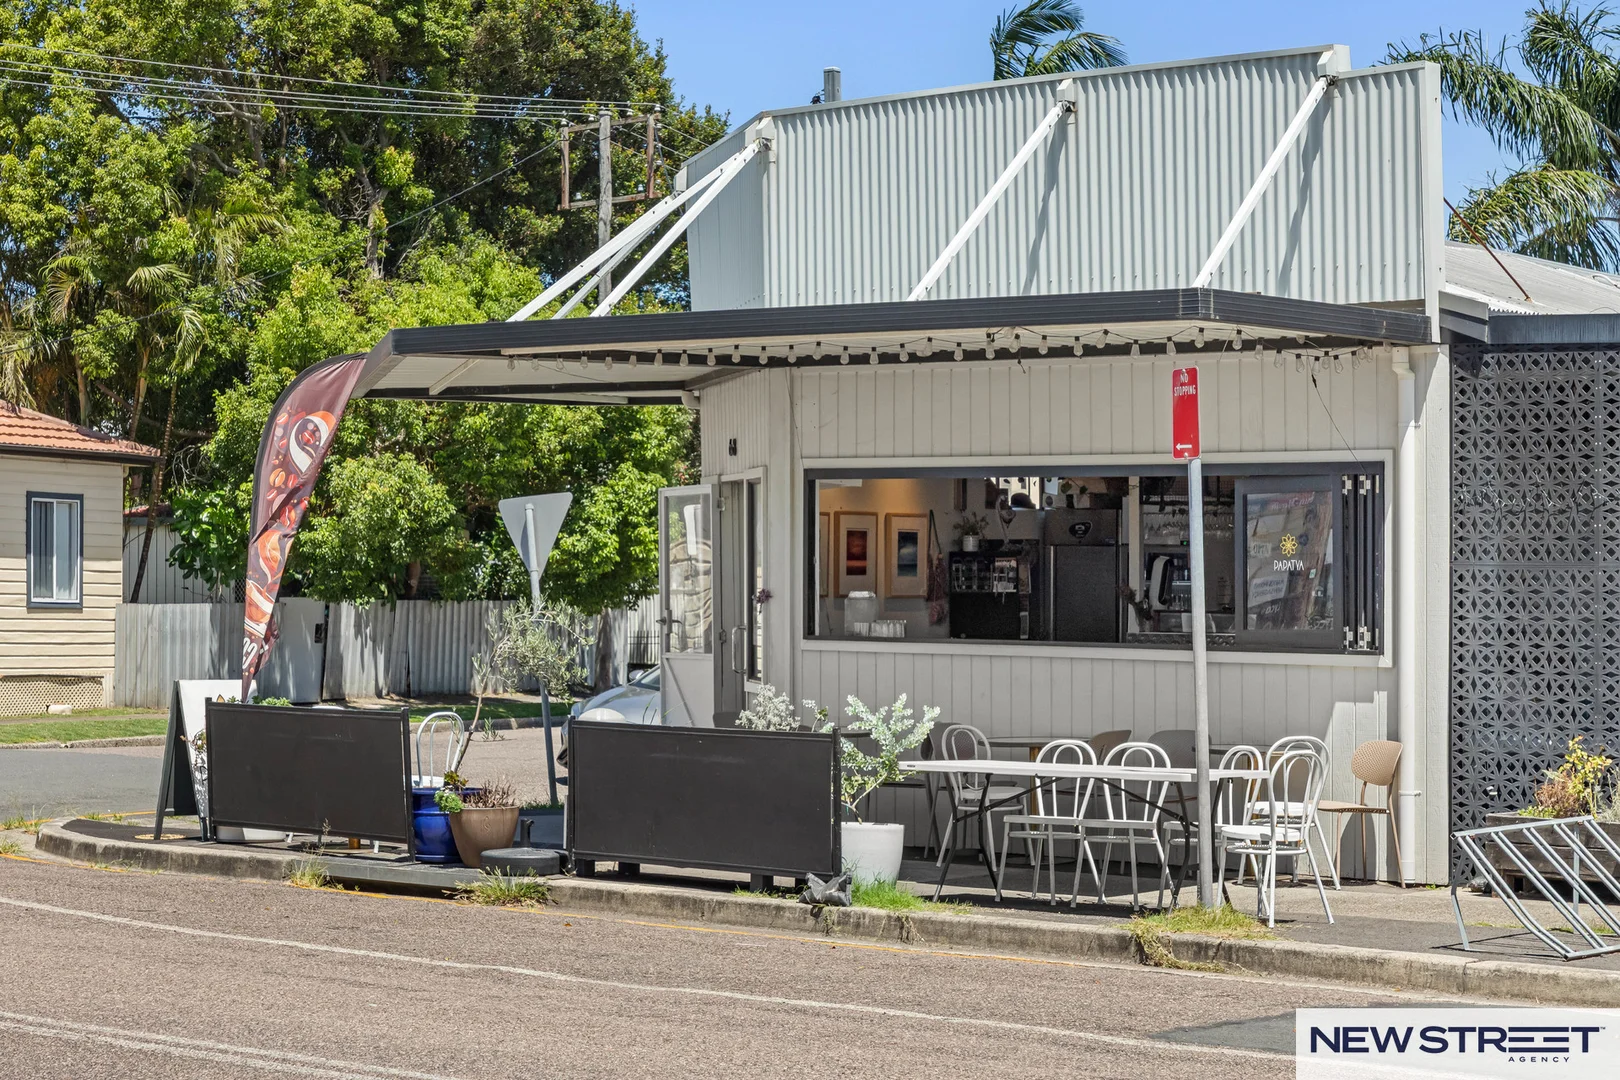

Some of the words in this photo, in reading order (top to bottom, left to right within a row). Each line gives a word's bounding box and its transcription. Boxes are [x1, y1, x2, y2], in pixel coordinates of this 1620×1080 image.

[1180, 373, 1189, 383] NO
[1174, 385, 1196, 396] STOPPING
[1273, 559, 1305, 571] PAPATYA
